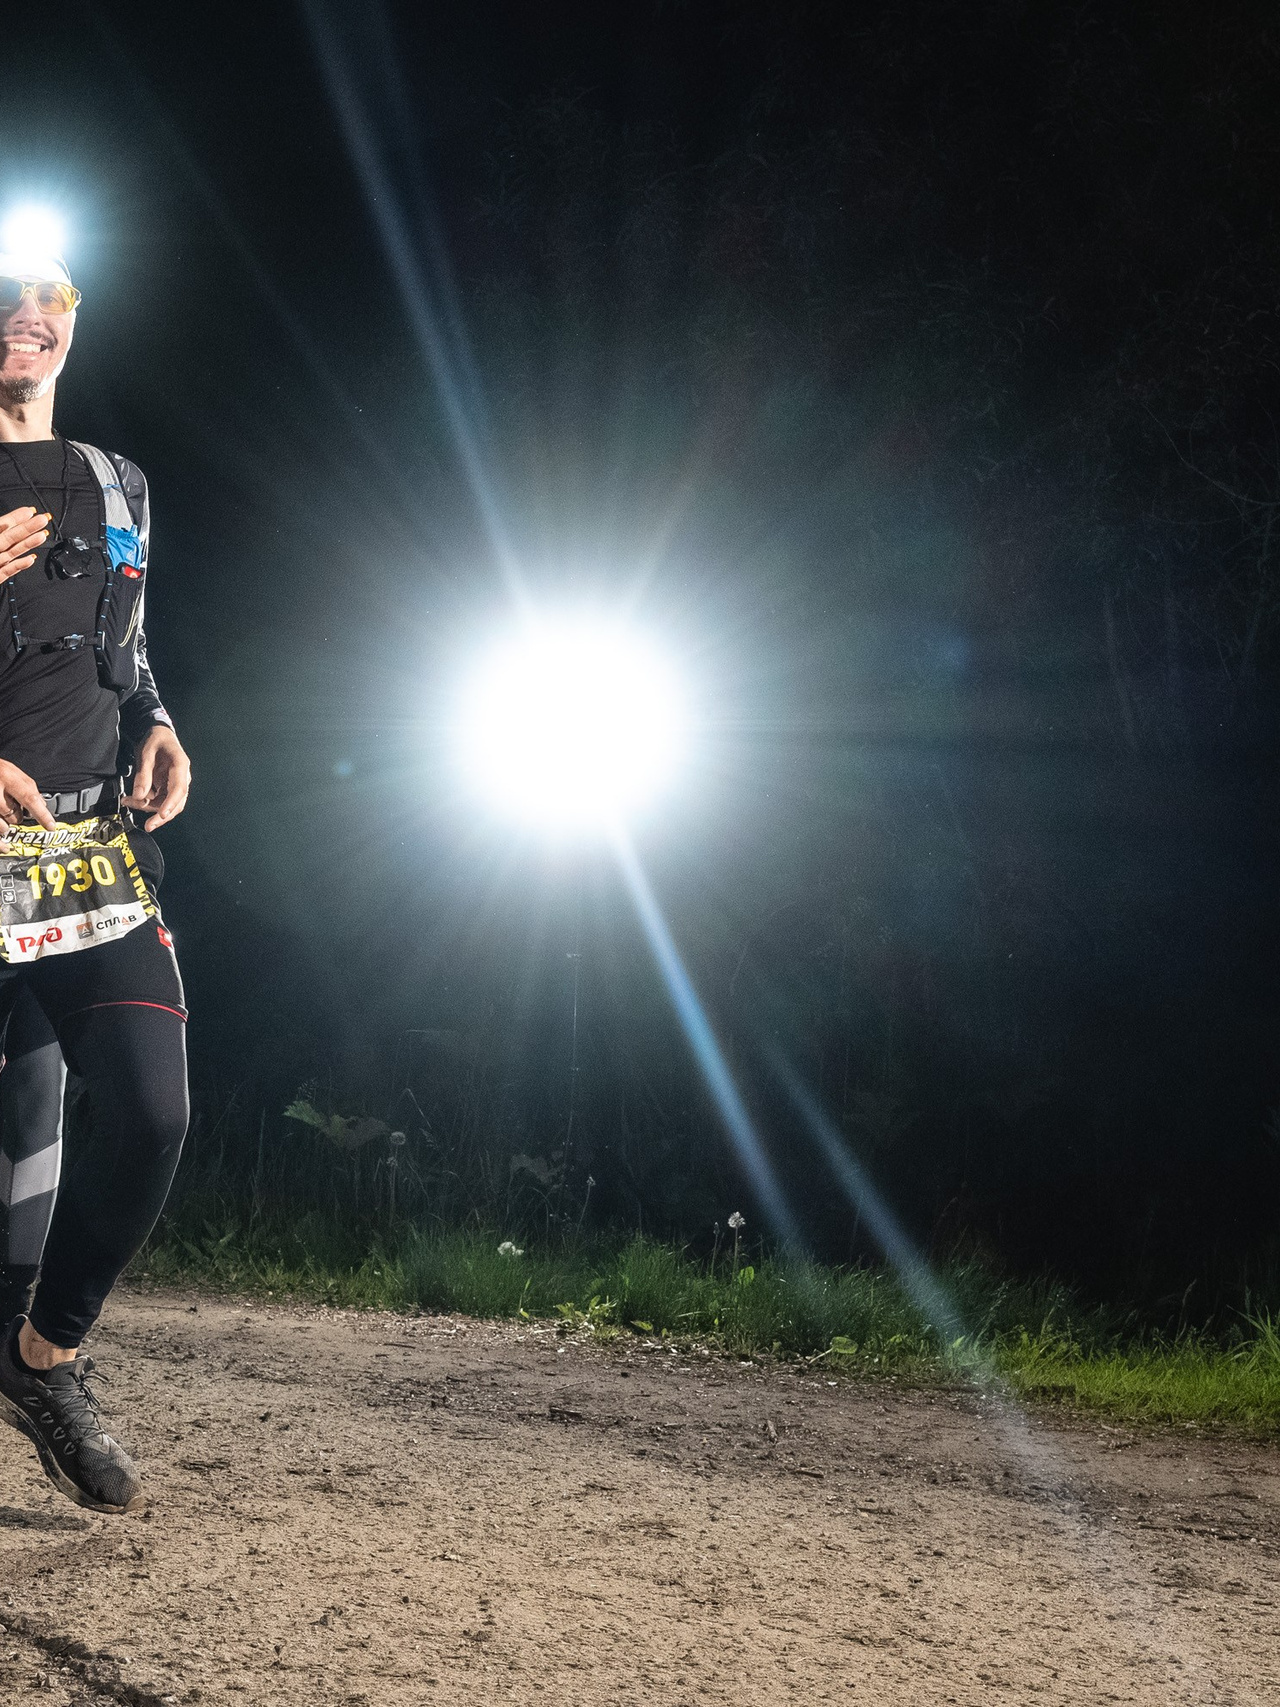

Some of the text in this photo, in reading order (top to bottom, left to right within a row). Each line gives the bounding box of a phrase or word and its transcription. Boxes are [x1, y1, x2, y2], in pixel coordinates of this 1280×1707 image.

[41, 846, 71, 858] 20K
[26, 855, 116, 900] 1930
[96, 915, 137, 930] СПЛАВ
